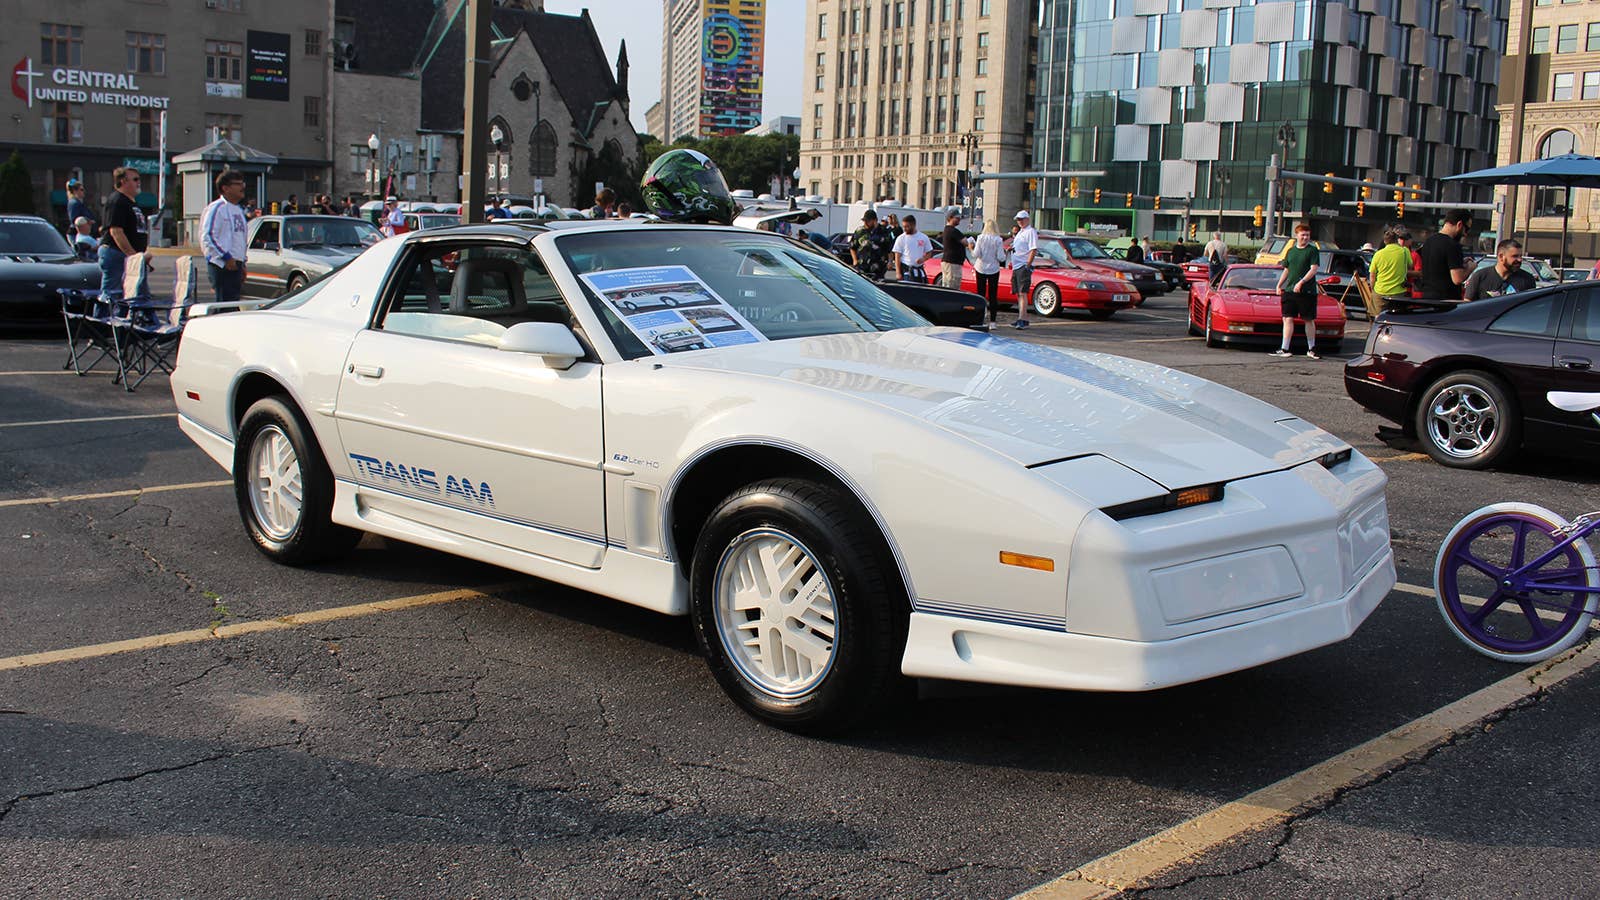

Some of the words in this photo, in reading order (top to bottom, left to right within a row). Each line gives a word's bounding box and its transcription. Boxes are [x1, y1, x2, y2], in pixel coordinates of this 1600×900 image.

[52, 68, 139, 91] CENTRAL
[35, 88, 88, 103] UNITED
[91, 91, 170, 109] METHODIST
[349, 452, 441, 495] TRANS
[446, 474, 496, 510] AM
